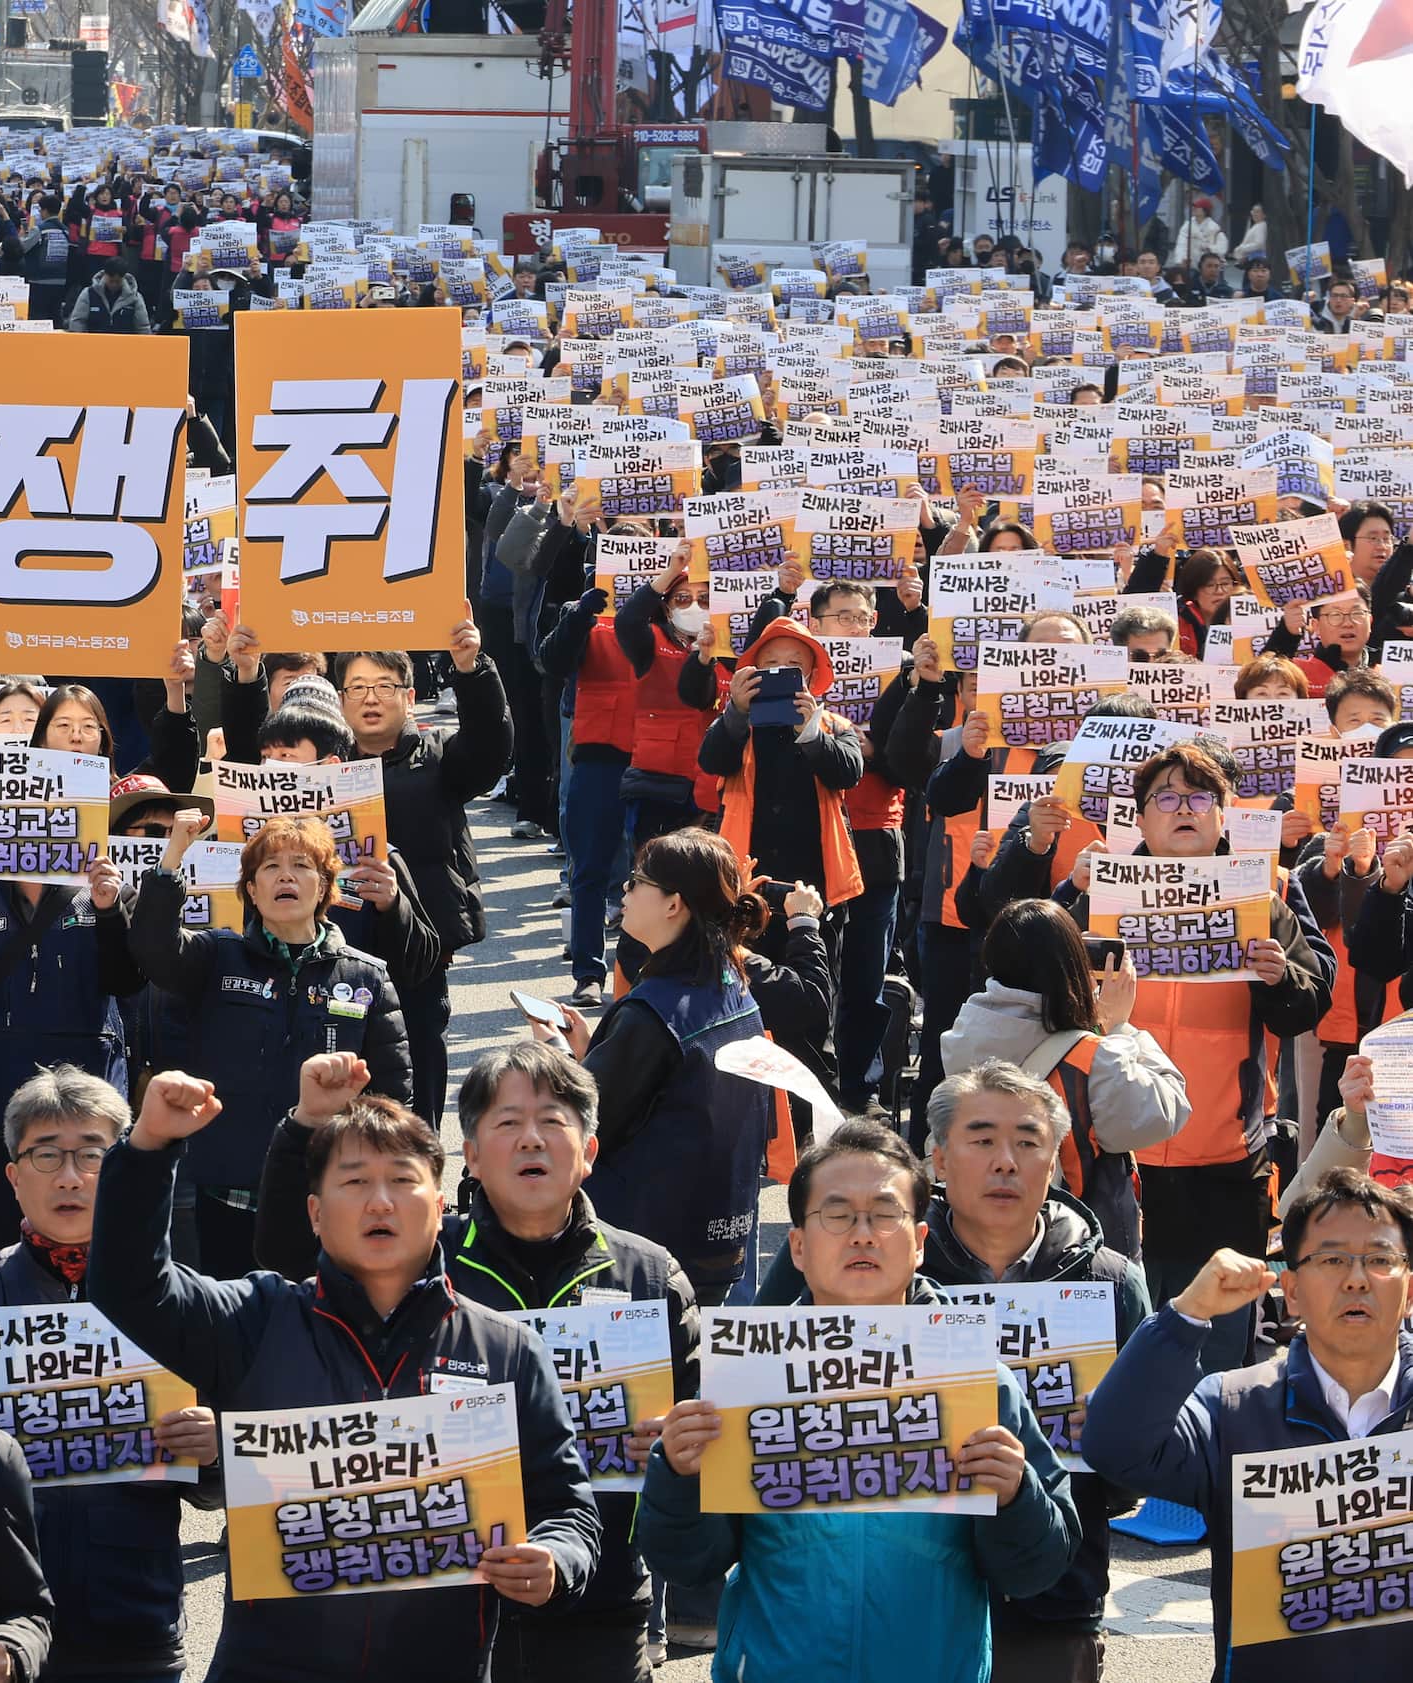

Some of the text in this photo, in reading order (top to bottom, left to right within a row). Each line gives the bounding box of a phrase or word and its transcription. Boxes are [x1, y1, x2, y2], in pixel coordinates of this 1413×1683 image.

[567, 290, 601, 304] 진짜사장
[584, 299, 615, 312] 나와라!
[914, 315, 946, 324] 진짜사장
[1049, 320, 1078, 330] 나와라!
[1251, 352, 1285, 364] 나와라!
[507, 391, 546, 405] 나와라!
[680, 382, 736, 398] 진짜사장
[703, 389, 742, 409] 나와라!
[692, 401, 751, 428] 원청교섭
[1118, 407, 1167, 421] 진짜사장
[1141, 421, 1186, 436] 나와라!
[589, 444, 641, 460] 진짜사장
[614, 457, 663, 474] 나와라!
[244, 378, 459, 585] 취
[599, 475, 672, 498] 원청교섭
[601, 495, 684, 517] 쟁취하자!
[801, 492, 862, 513] 진짜사장
[829, 512, 885, 531] 나와라!
[810, 532, 893, 557] 원청교섭
[1233, 525, 1281, 546] 진짜사장
[1259, 536, 1308, 561] 나와라!
[809, 556, 905, 580] 쟁취하자!
[1256, 556, 1325, 586] 원청교섭
[1266, 572, 1344, 602] 쟁취하자!
[312, 610, 415, 624] 전국금속노동조합
[26, 634, 129, 649] 전국금속노동조합
[1095, 858, 1186, 884] 진짜사장
[1142, 879, 1221, 908] 나와라!
[1118, 911, 1236, 944] 원청교섭
[1129, 939, 1259, 975] 쟁취하자!
[223, 977, 263, 992] 단결투쟁
[1073, 1289, 1107, 1300] 민주노총
[625, 1307, 660, 1321] 민주노총
[945, 1313, 986, 1326] 민주노총
[710, 1315, 855, 1357] 진짜사장
[4, 1336, 122, 1385] 나와라!
[447, 1358, 488, 1375] 민주노총
[786, 1343, 914, 1394] 나와라!
[466, 1392, 507, 1410] 민주노총
[747, 1392, 942, 1456] 원청교섭
[232, 1411, 380, 1459] 진짜사장
[23, 1427, 173, 1478] 취하자
[310, 1433, 439, 1490] 나와라!
[1242, 1446, 1380, 1499] 진짜사장
[275, 1477, 469, 1546] 원청교섭
[280, 1523, 505, 1592] 쟁취하자!
